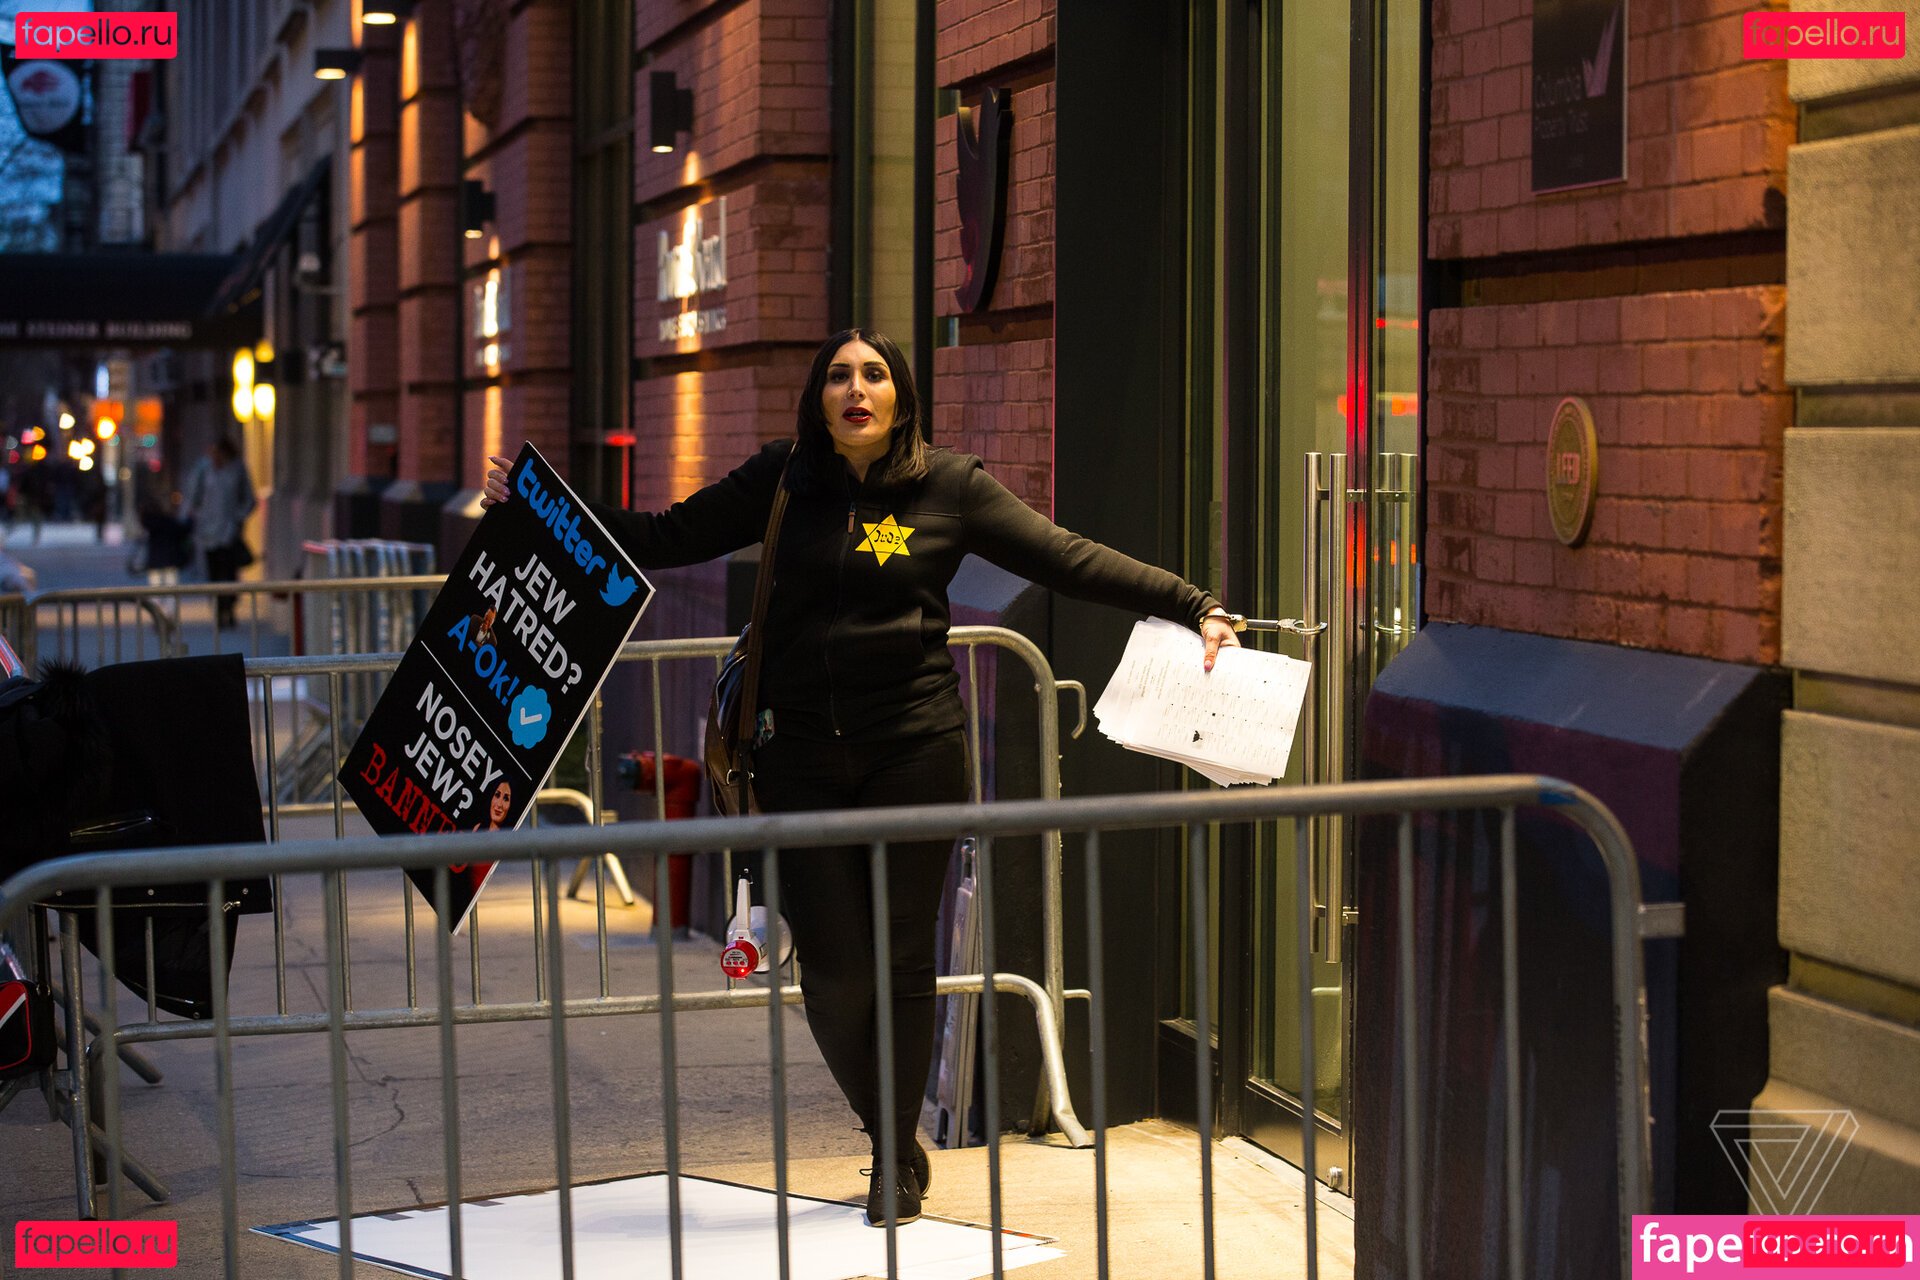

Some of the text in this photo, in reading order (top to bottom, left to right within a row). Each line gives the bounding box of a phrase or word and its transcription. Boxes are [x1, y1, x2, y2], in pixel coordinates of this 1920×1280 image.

[517, 458, 606, 575] twitter
[468, 551, 583, 694] HATRED?
[514, 554, 577, 625] JEW
[404, 732, 474, 819] JEW?
[416, 681, 503, 793] NOSEY
